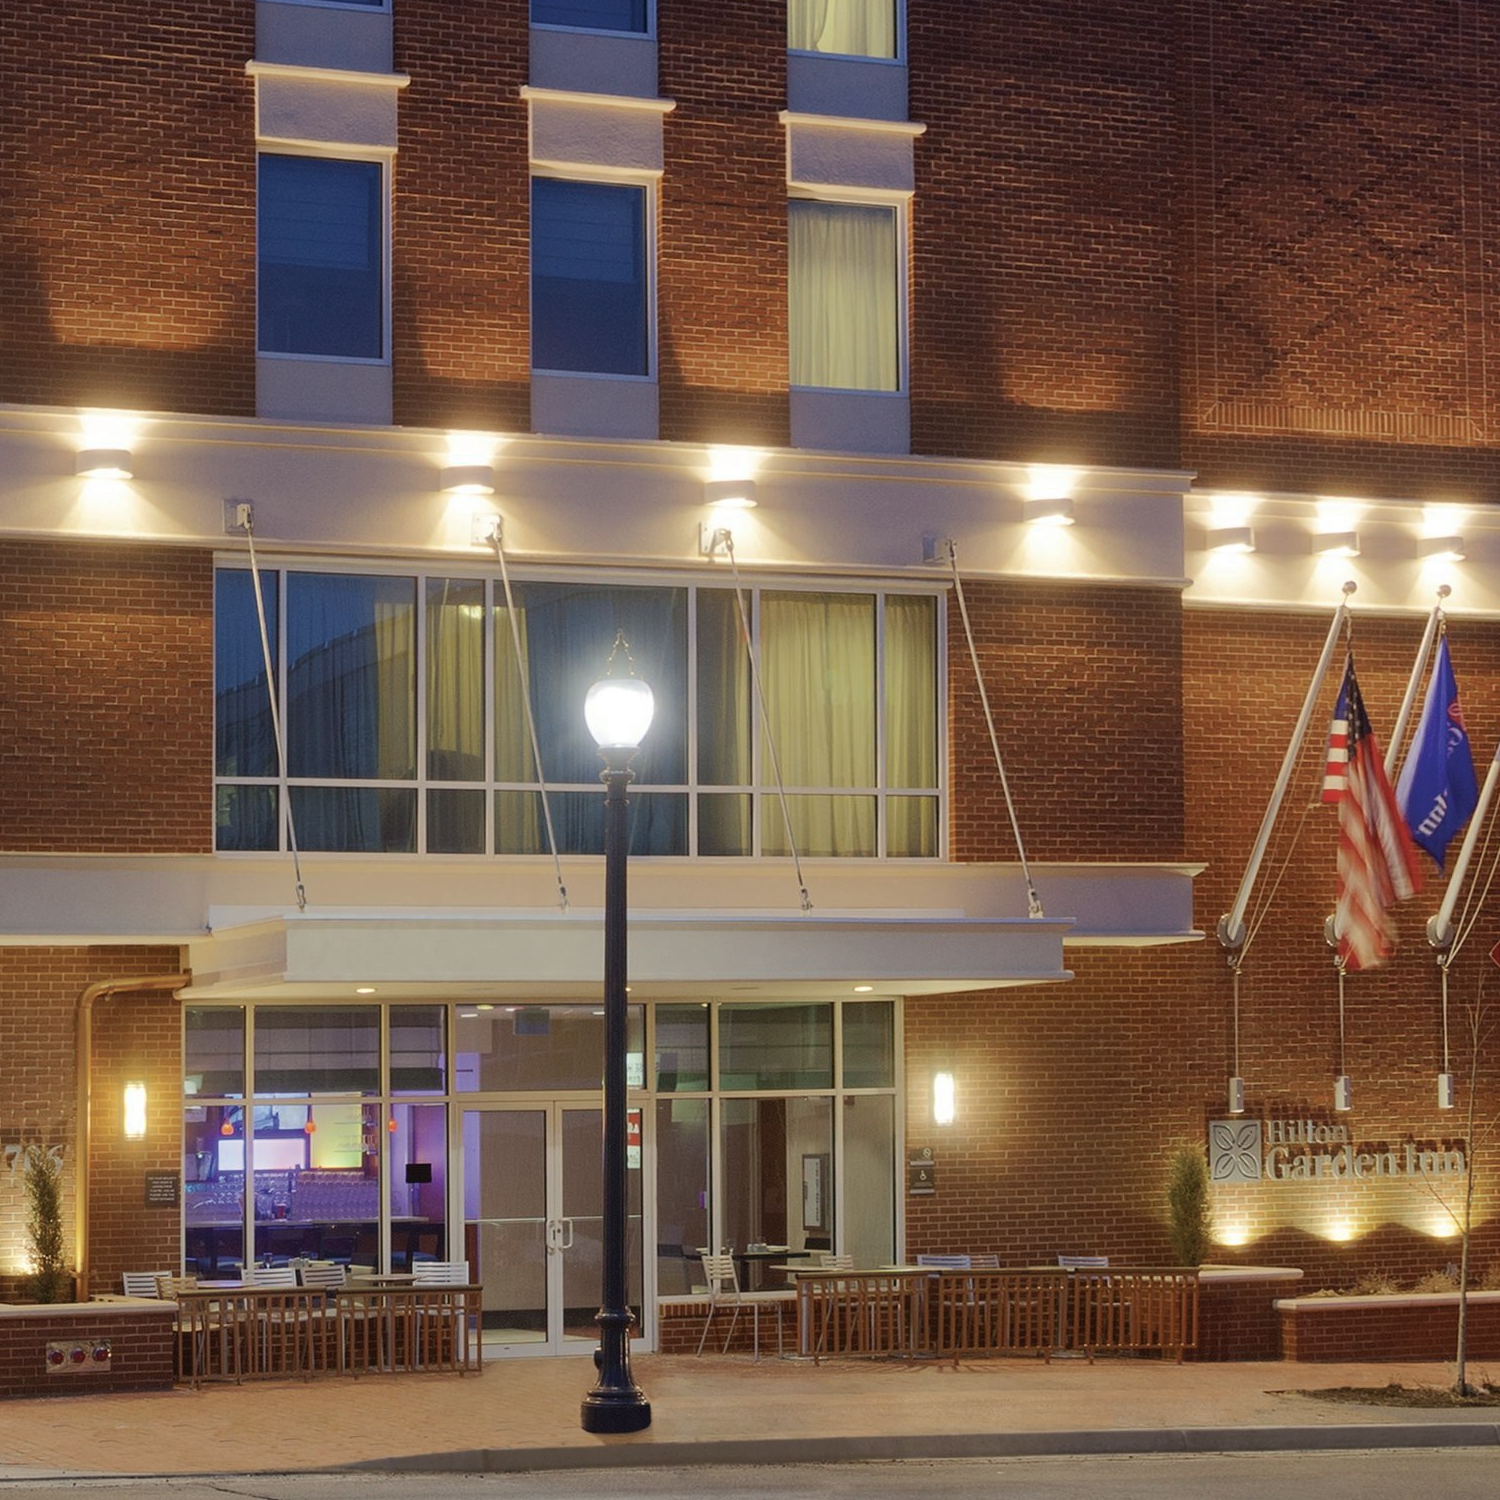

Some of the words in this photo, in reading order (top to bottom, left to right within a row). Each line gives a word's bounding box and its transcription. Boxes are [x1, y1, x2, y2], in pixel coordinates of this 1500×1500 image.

[1266, 1119, 1348, 1145] Hilton
[1265, 1144, 1399, 1181] Garden
[1404, 1142, 1467, 1177] Inn
